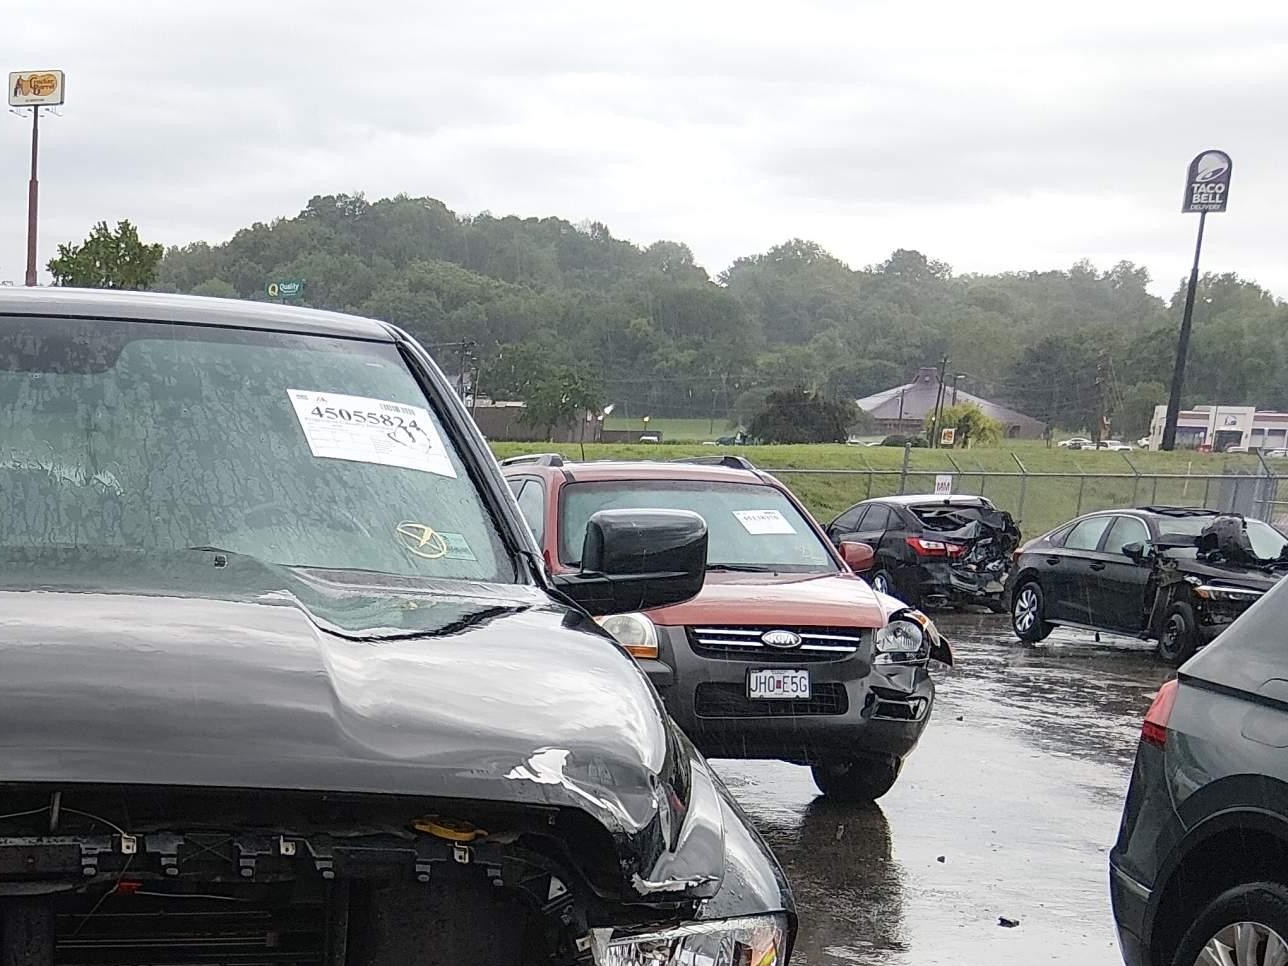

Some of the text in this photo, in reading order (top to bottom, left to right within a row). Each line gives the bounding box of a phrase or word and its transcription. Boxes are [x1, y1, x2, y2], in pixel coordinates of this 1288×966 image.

[1192, 183, 1225, 194] TACO
[1192, 193, 1223, 203] BELL
[311, 406, 421, 431] 45055824
